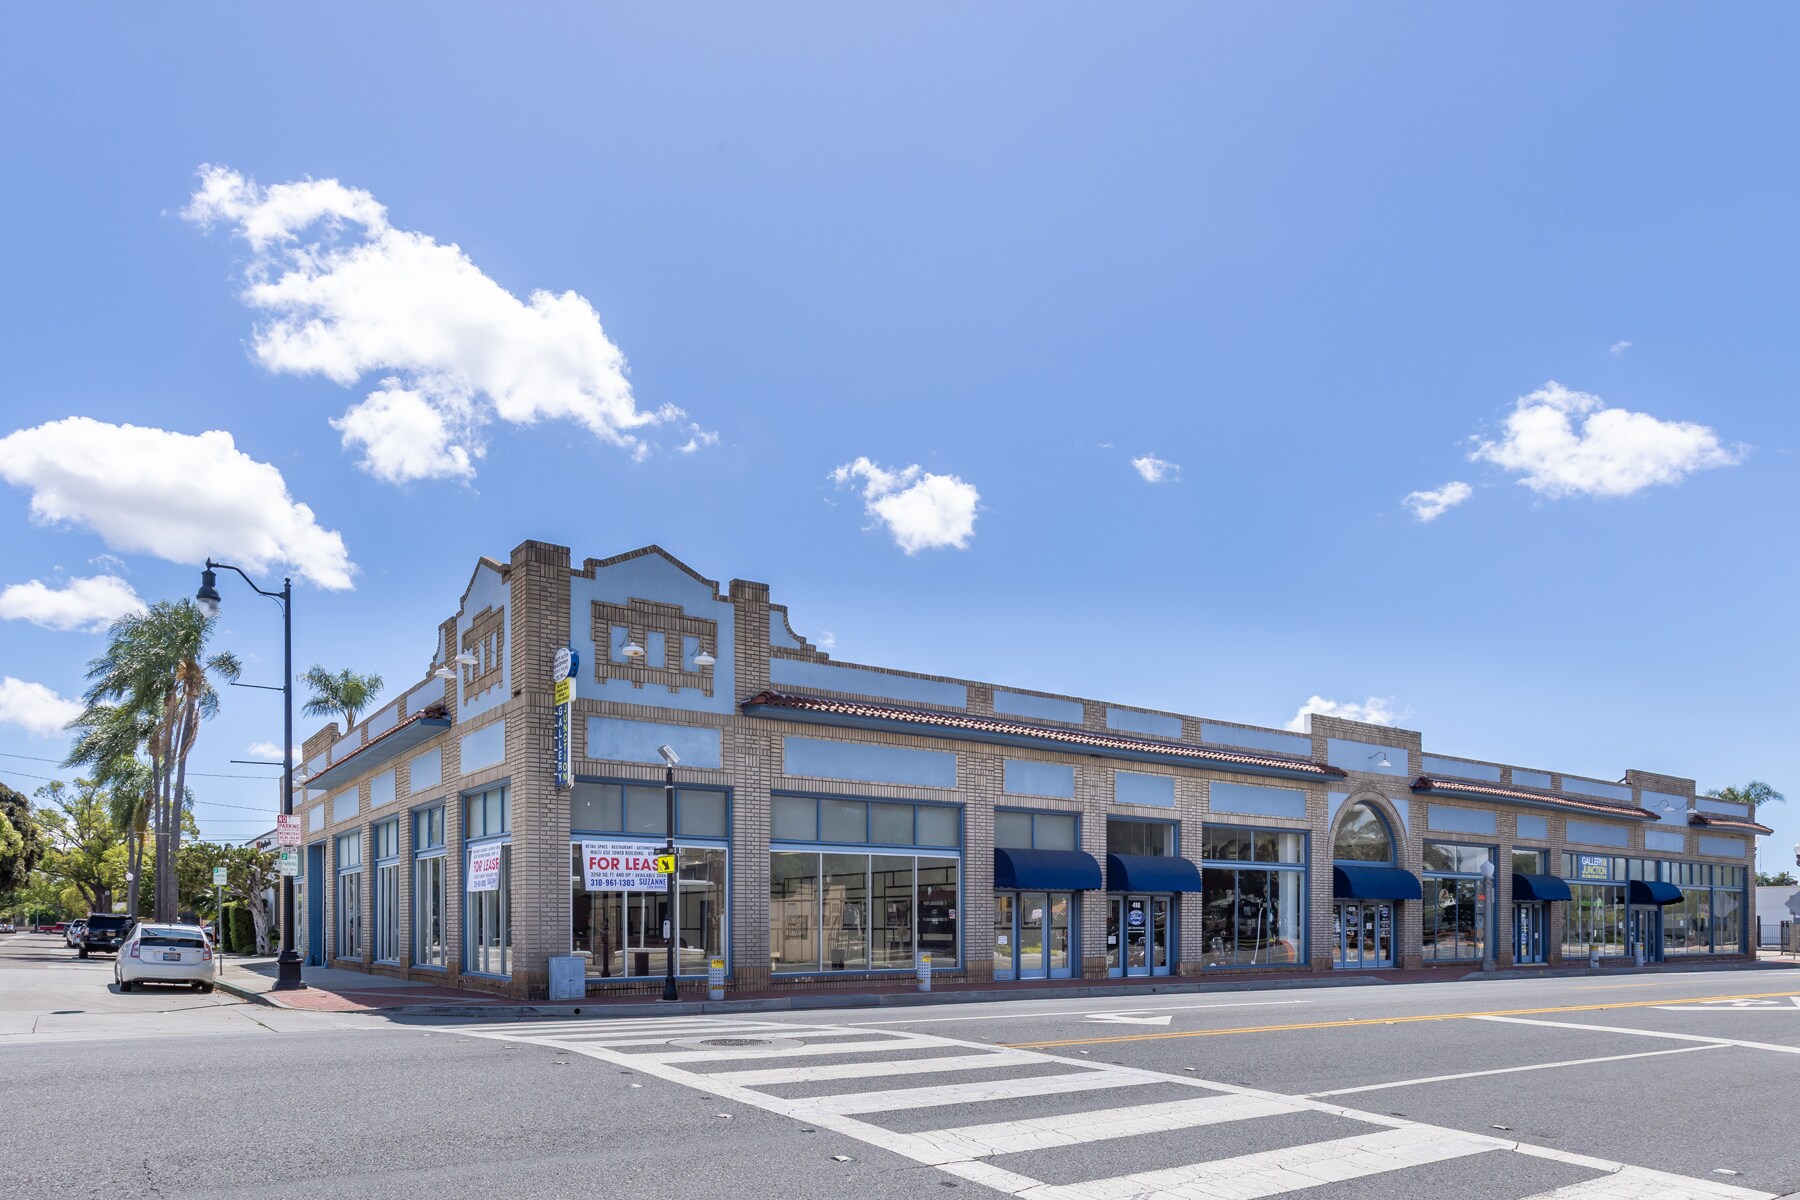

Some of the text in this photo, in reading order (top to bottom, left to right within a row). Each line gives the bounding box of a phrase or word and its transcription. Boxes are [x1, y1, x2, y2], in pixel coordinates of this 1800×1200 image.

[483, 857, 499, 872] LEASE
[590, 857, 658, 870] FOR LEAS
[1582, 857, 1603, 865] GALLERY
[1582, 866, 1607, 875] JUNCTION
